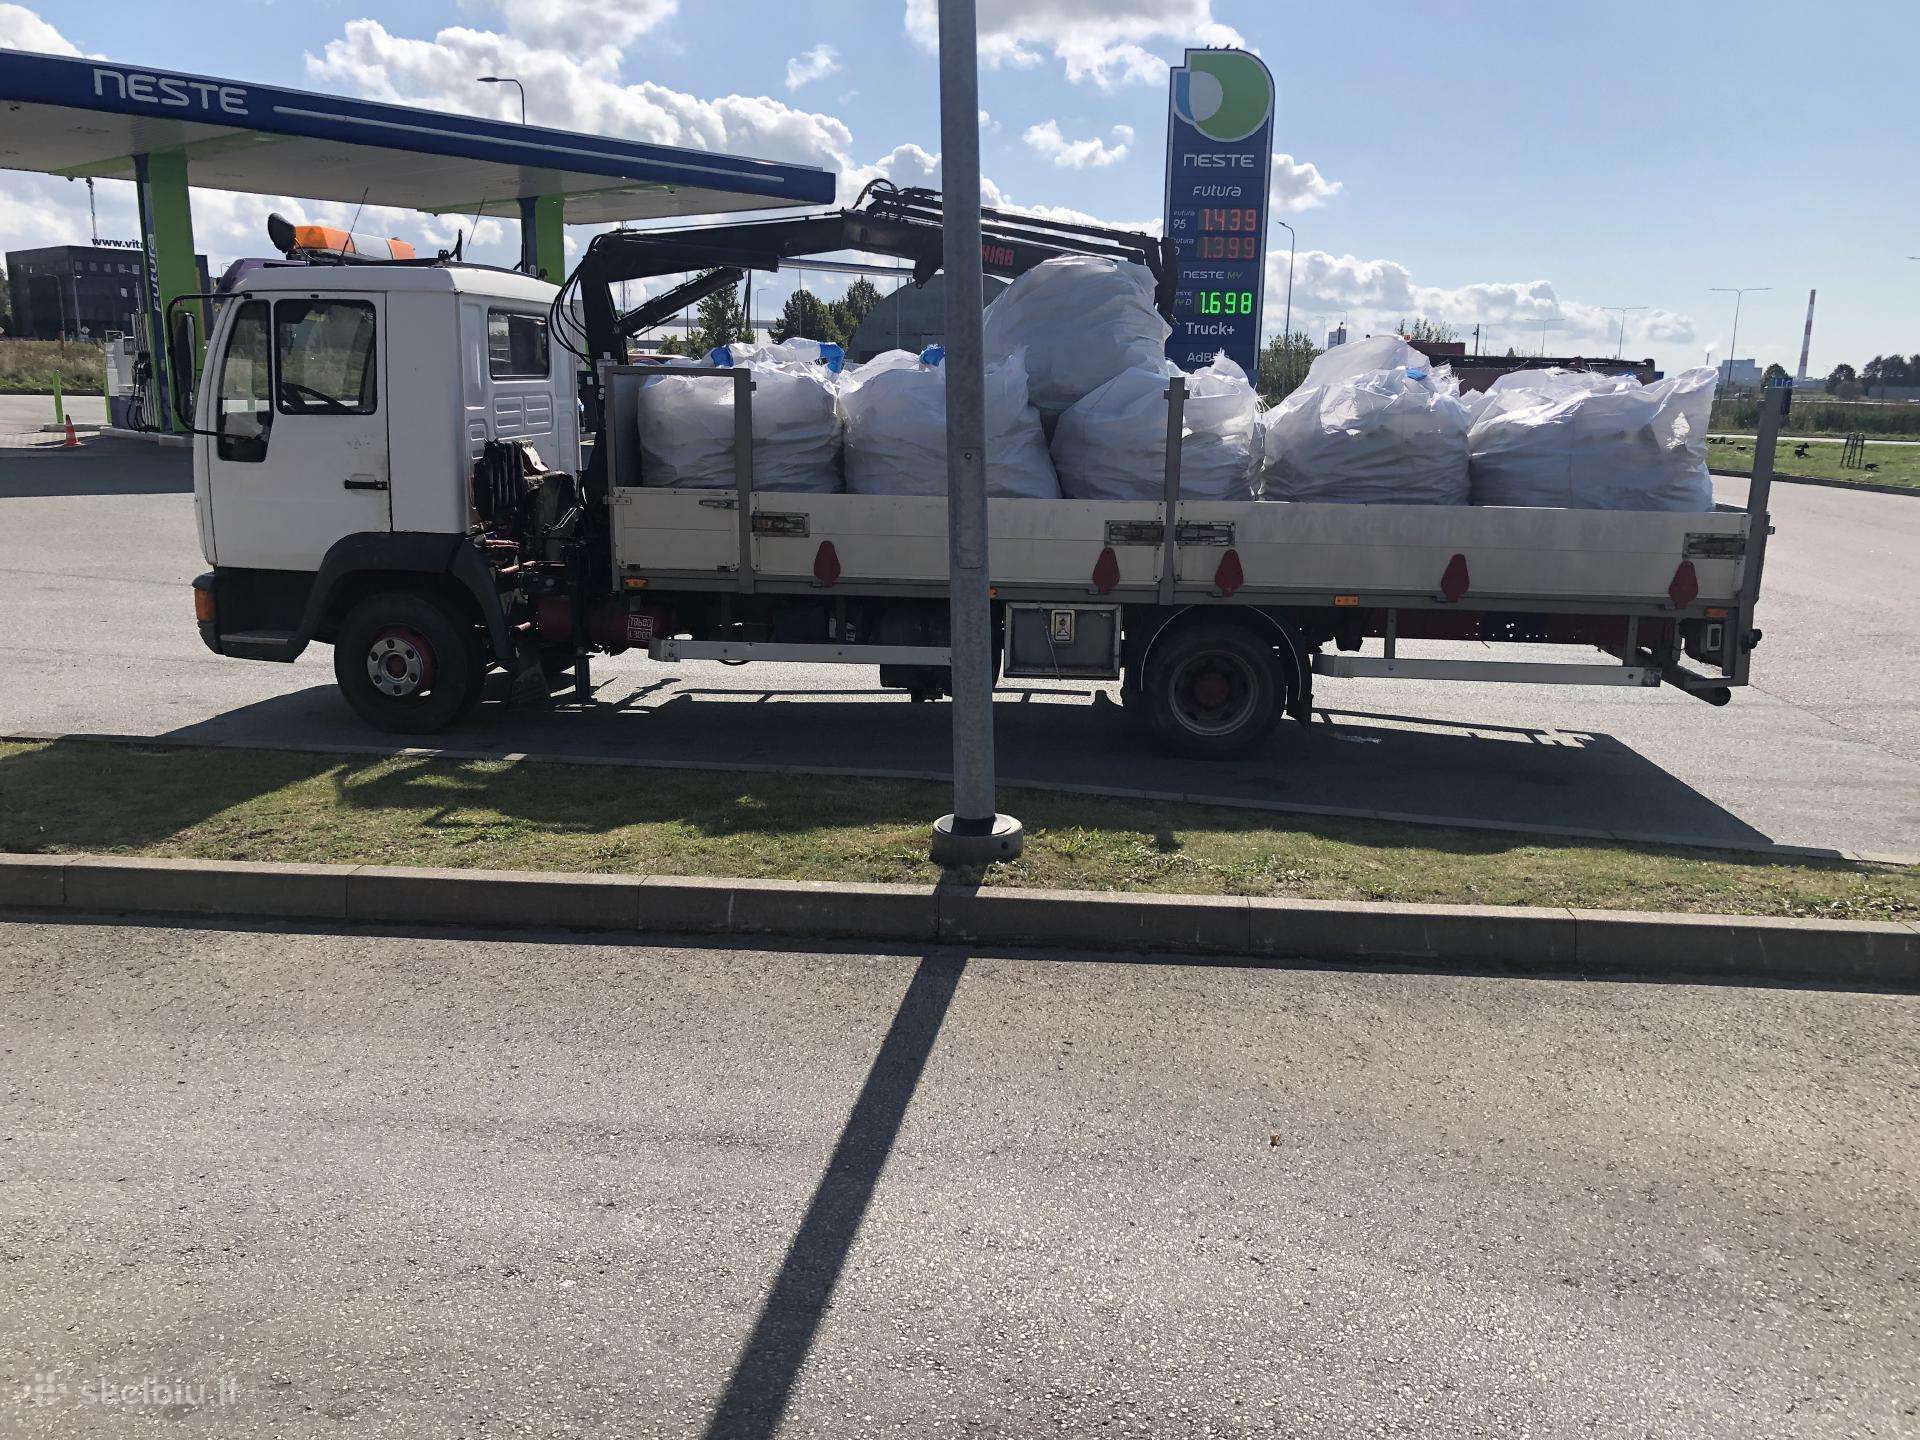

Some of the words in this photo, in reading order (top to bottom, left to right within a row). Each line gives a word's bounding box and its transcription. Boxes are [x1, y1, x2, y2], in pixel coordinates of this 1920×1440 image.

[93, 68, 249, 115] NESTE
[1183, 153, 1255, 168] NESTE
[1192, 184, 1242, 197] Futura
[1173, 219, 1187, 229] 95
[1203, 208, 1257, 231] 1.439
[91, 238, 143, 249] www.vit
[1202, 236, 1256, 259] 1.399
[1183, 270, 1225, 279] NESTE
[1200, 291, 1252, 314] 1.698
[1185, 322, 1236, 335] Truck+
